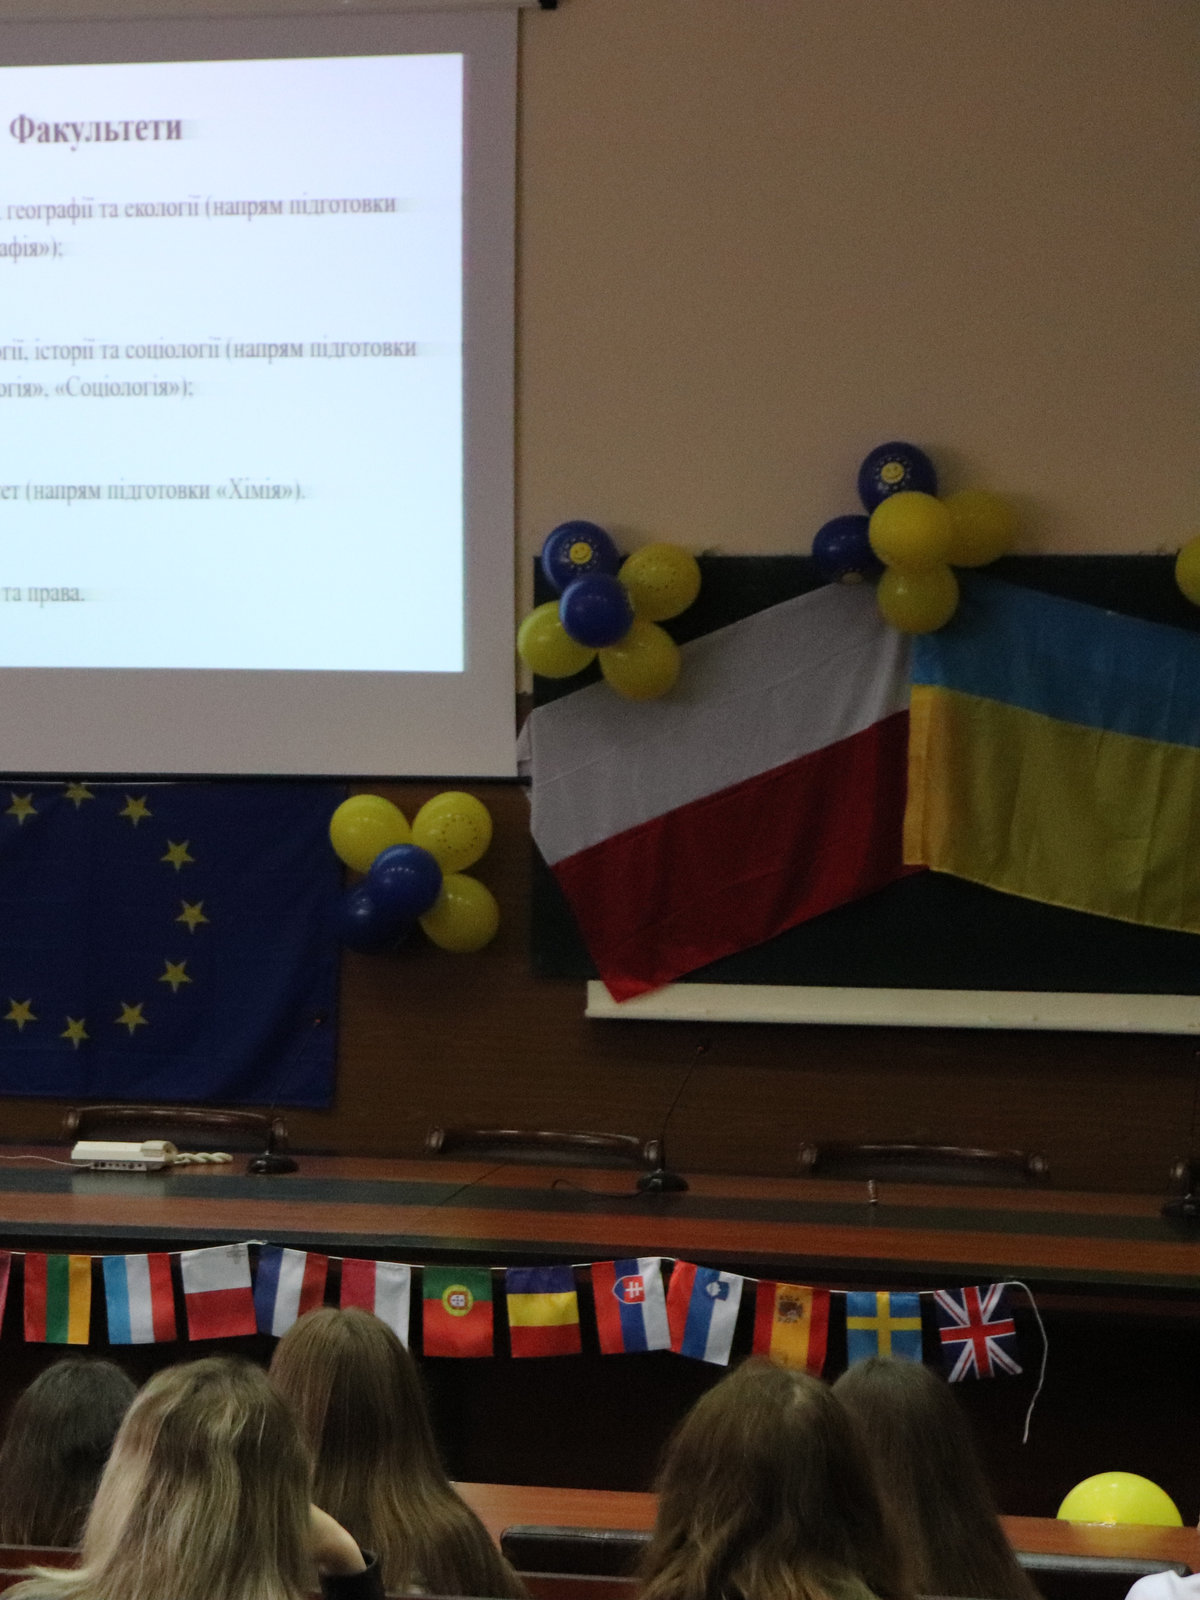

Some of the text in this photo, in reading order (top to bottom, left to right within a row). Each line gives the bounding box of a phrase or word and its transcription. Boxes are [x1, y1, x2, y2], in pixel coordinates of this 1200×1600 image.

[9, 113, 182, 151] Факультети
[6, 198, 94, 225] географії
[99, 202, 119, 219] та
[125, 196, 200, 219] екології
[205, 198, 283, 221] (напрям
[290, 193, 396, 216] підготовки
[34, 340, 94, 365] історії
[99, 342, 120, 359] та
[125, 338, 219, 361] соціології
[226, 339, 303, 364] (напрям
[309, 337, 417, 360] підготовки
[26, 479, 100, 505] (напрям
[107, 479, 210, 502] підготовки
[1, 584, 21, 601] та
[27, 584, 84, 605] права.
